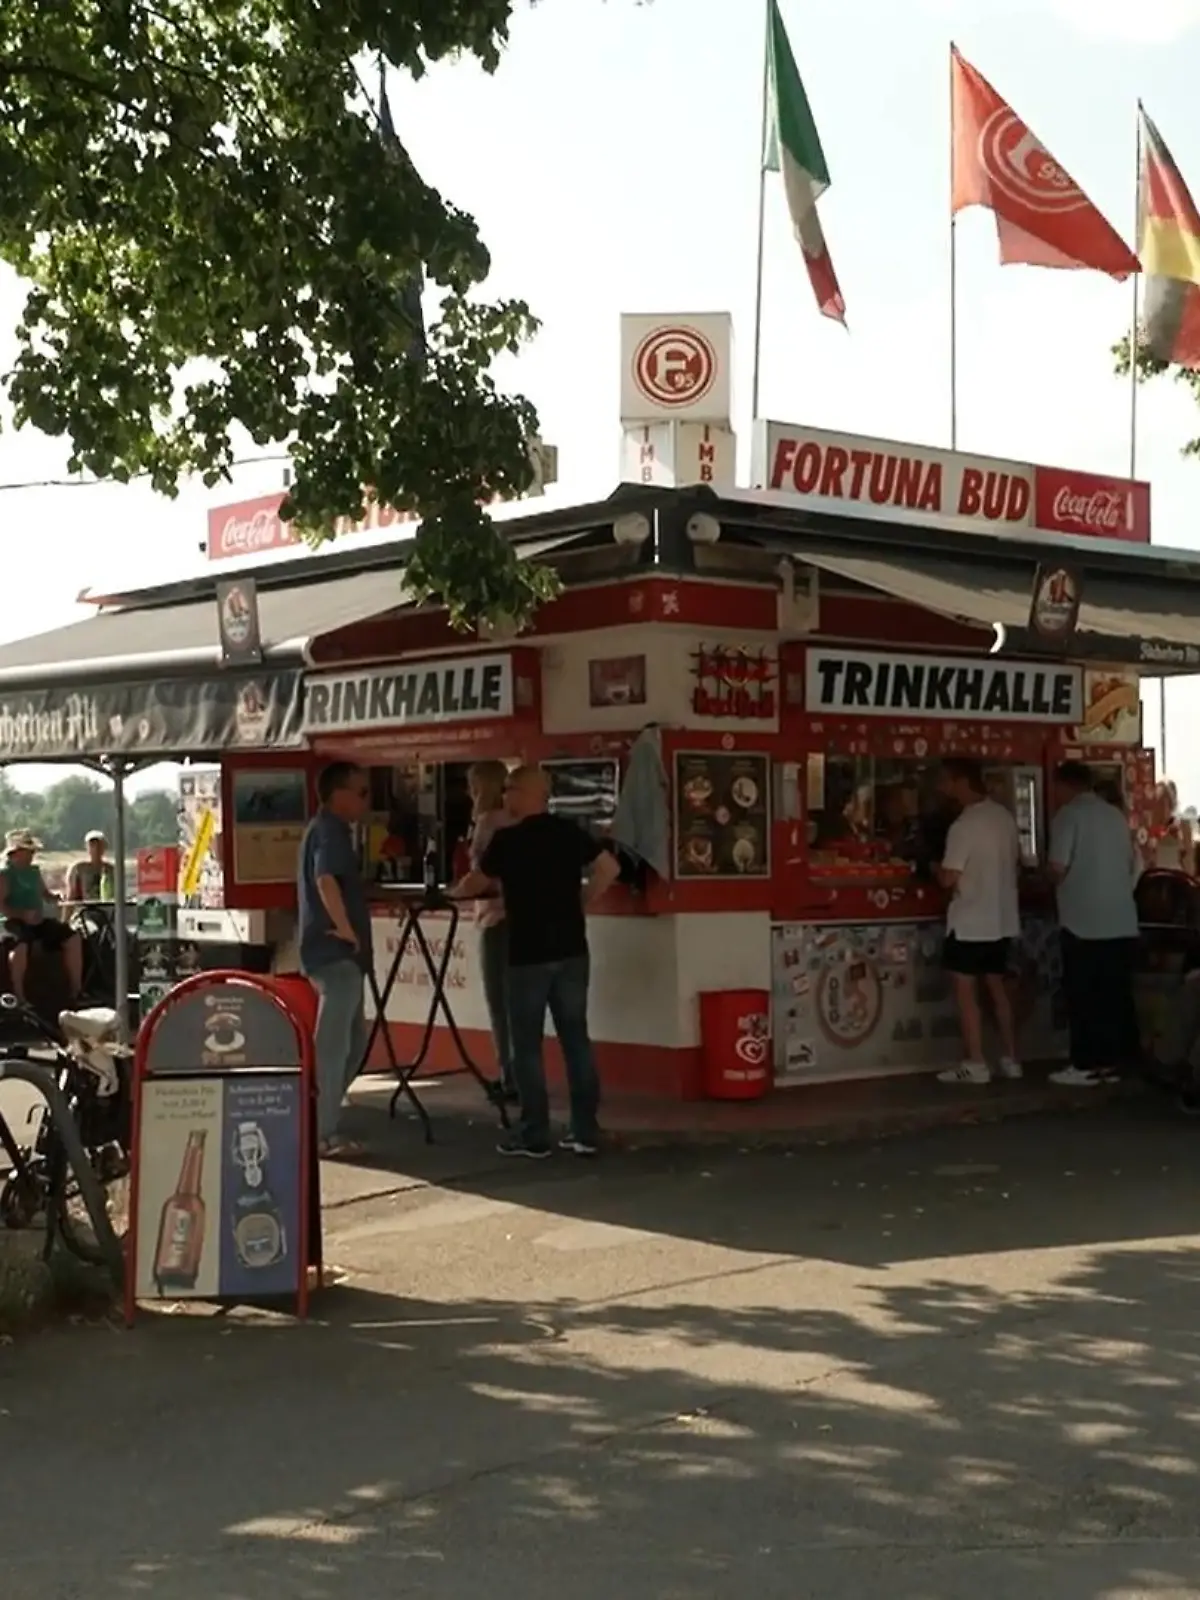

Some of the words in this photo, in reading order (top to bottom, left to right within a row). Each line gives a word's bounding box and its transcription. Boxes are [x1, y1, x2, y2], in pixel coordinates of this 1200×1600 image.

[770, 439, 944, 512] FORTUNA
[958, 468, 1031, 522] BUD
[304, 665, 503, 724] RINKHALLE
[817, 659, 1073, 714] TRINKHALLE
